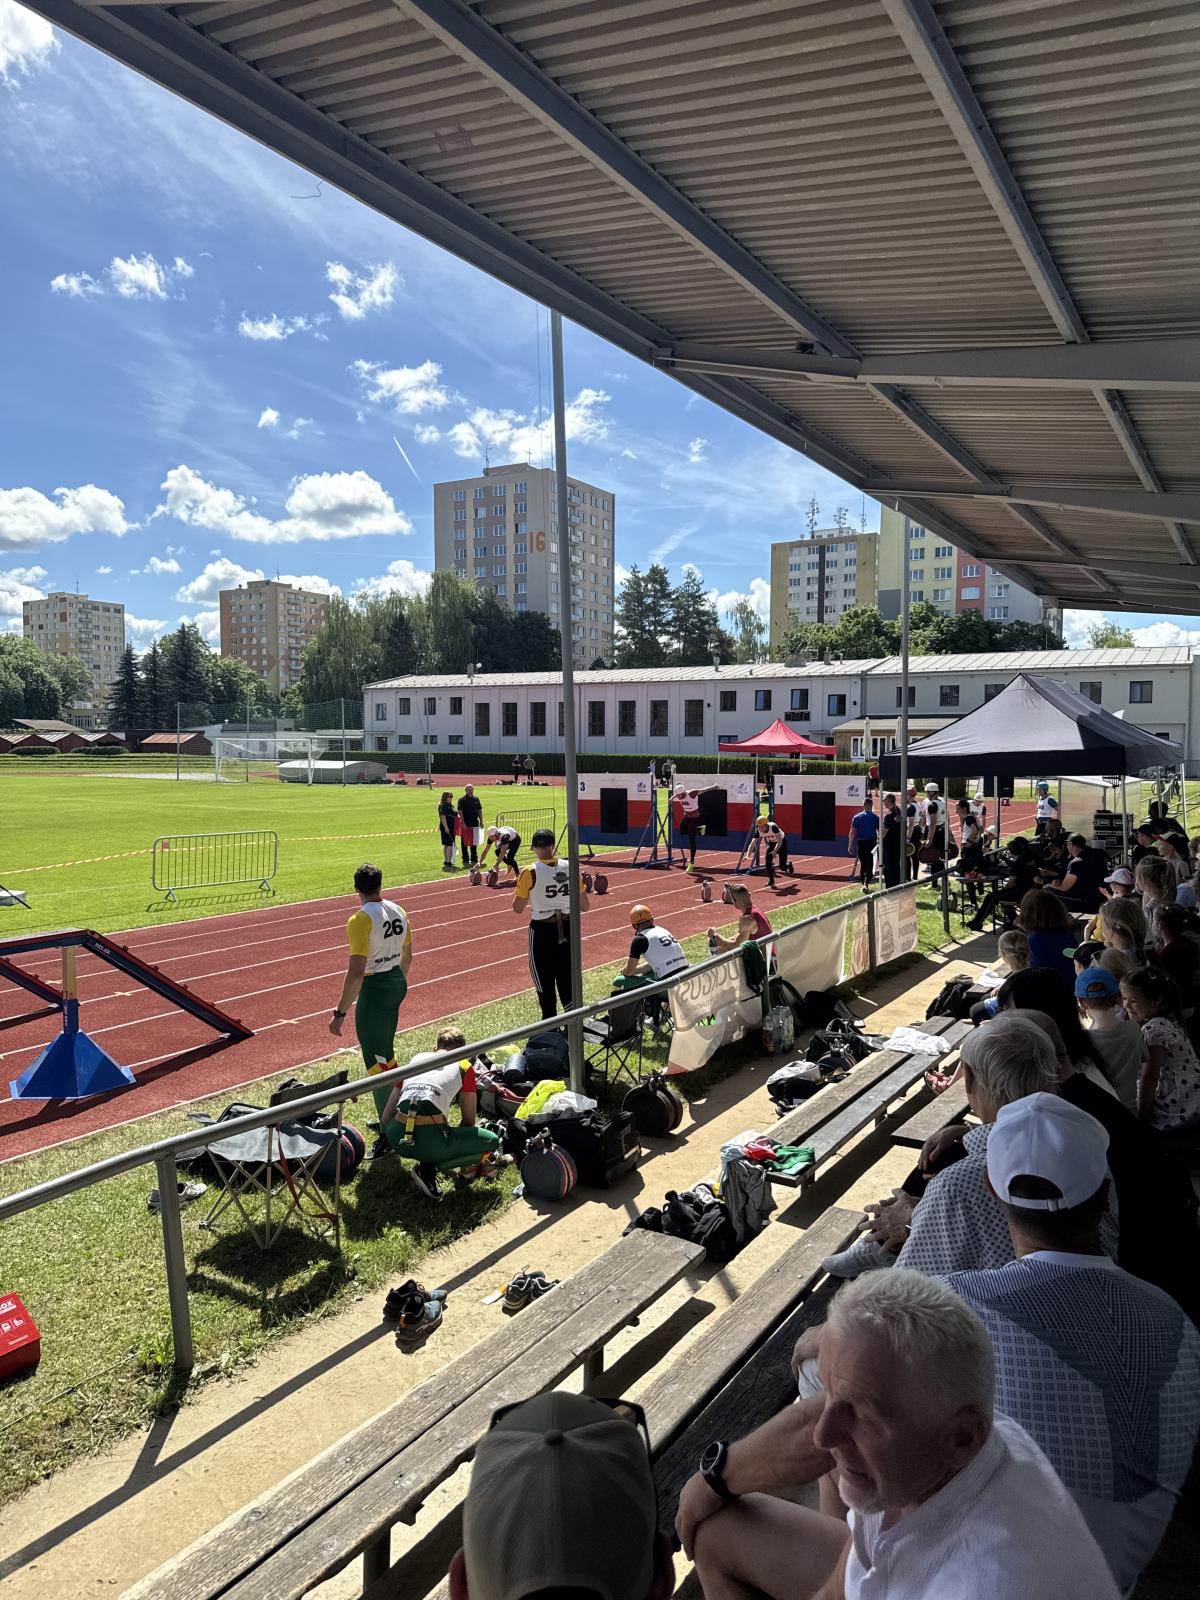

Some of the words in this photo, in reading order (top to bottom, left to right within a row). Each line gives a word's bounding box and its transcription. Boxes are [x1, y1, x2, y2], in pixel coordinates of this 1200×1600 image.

[529, 531, 545, 553] 16
[580, 781, 586, 792] 3
[779, 784, 784, 796] 1
[545, 883, 570, 899] 54
[382, 918, 404, 940] 26
